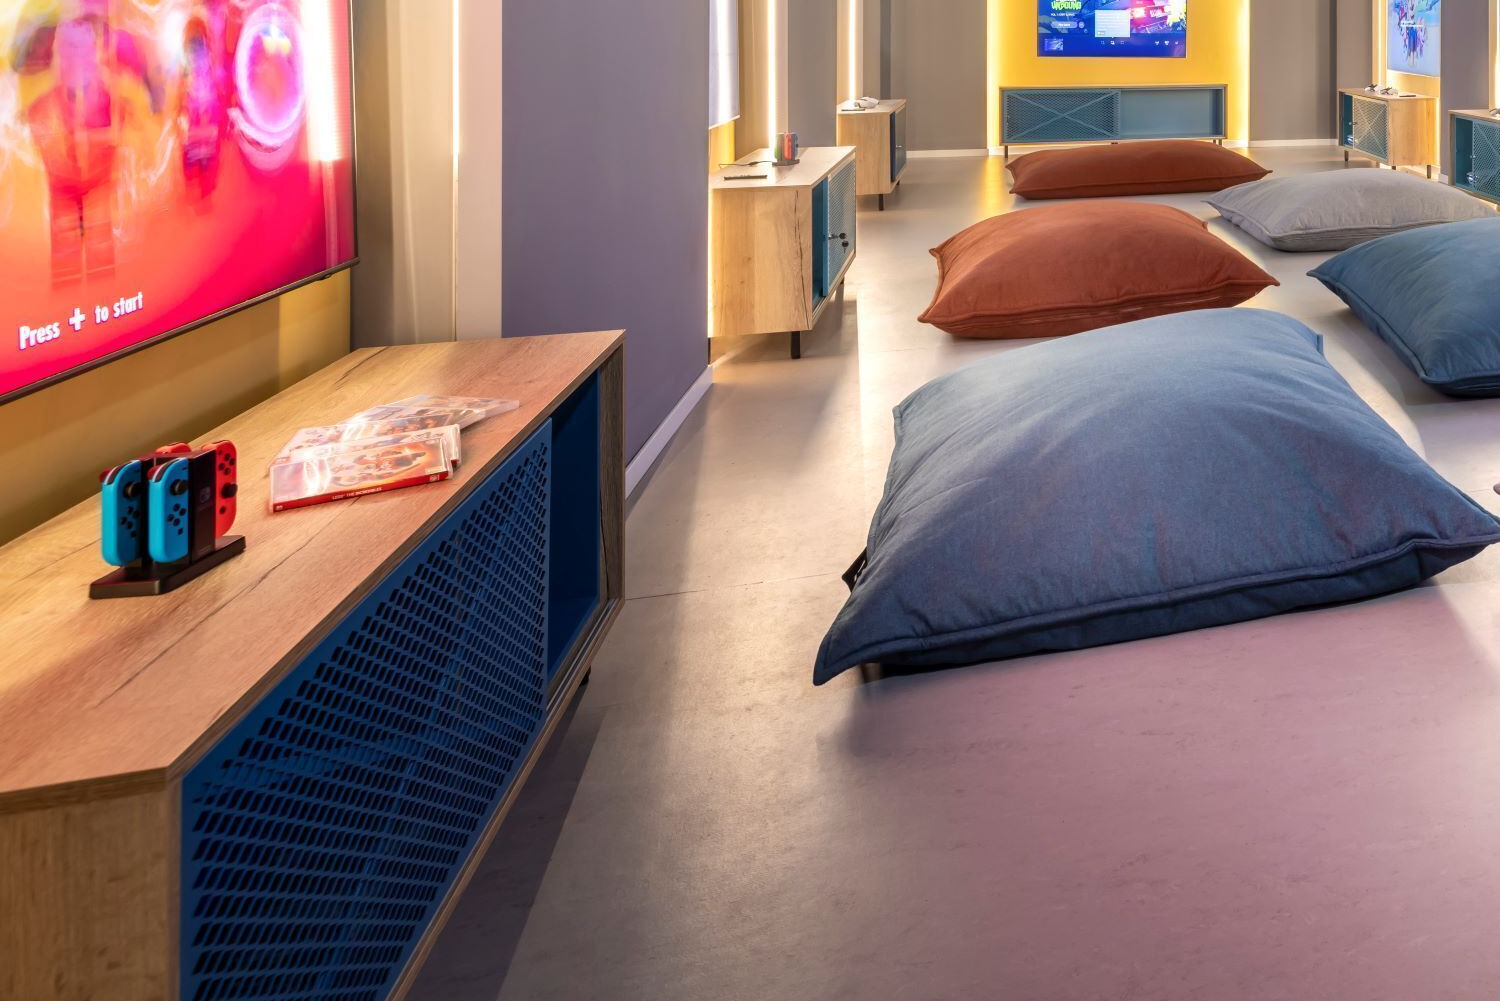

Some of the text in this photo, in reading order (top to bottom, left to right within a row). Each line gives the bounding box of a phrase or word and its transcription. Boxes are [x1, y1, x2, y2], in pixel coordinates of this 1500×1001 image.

[19, 322, 61, 351] Press
[95, 305, 110, 324] to
[113, 291, 144, 319] start
